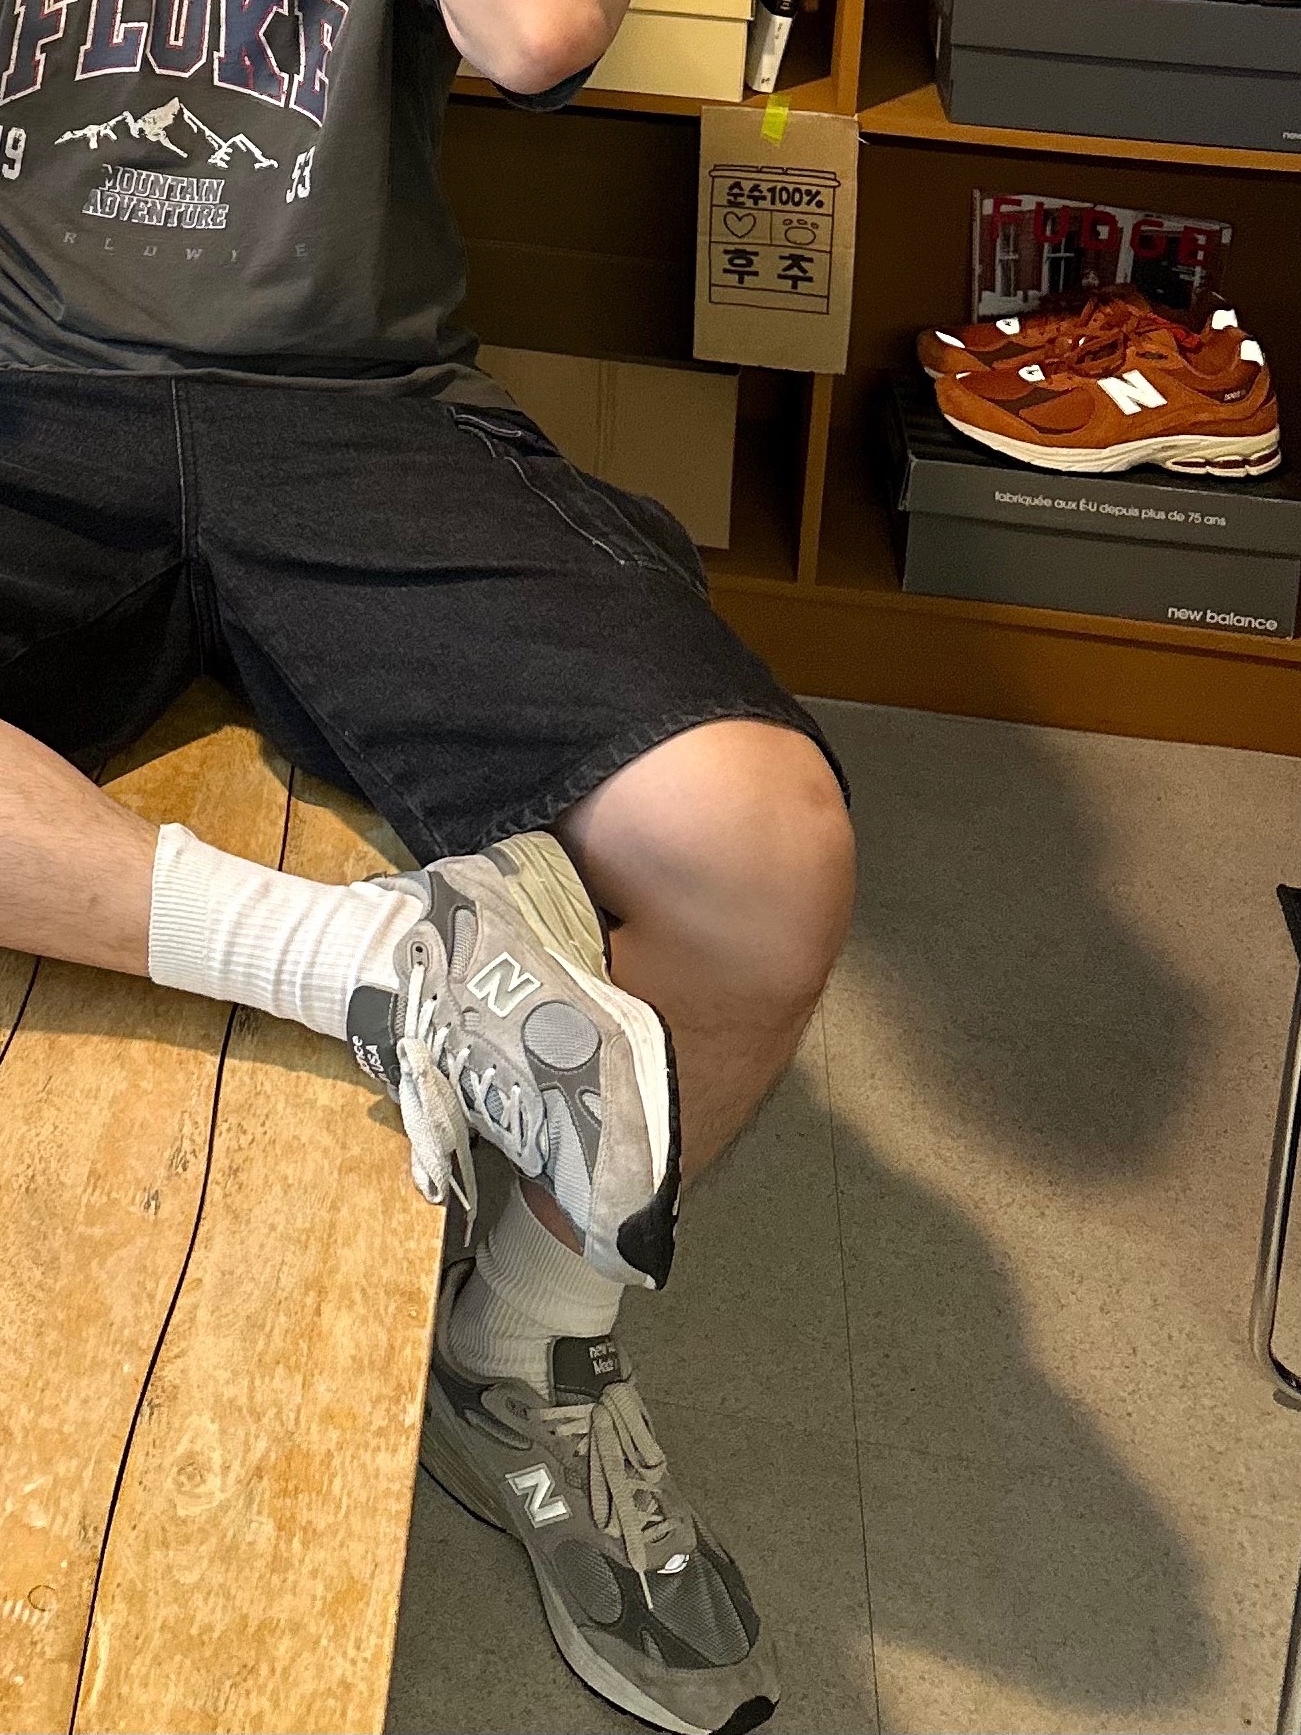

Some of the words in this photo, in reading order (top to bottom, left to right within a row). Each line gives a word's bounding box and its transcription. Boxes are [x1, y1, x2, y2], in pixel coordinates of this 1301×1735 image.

[98, 164, 226, 203] MOUNTAIN
[726, 180, 824, 209] 순수100%
[82, 189, 229, 229] ADVENTURE
[990, 197, 1216, 267] FUDGE
[1098, 369, 1168, 416] N
[995, 491, 1052, 508] fabriquée
[1054, 499, 1077, 511] aux
[1099, 502, 1140, 518] depuis
[1141, 507, 1166, 521] plus
[1168, 509, 1185, 522] de
[1187, 511, 1202, 524] 75
[1204, 515, 1227, 527] ans
[1168, 606, 1203, 623] new
[1206, 609, 1279, 632] balance
[466, 951, 542, 1018] N
[505, 1463, 572, 1528] N
